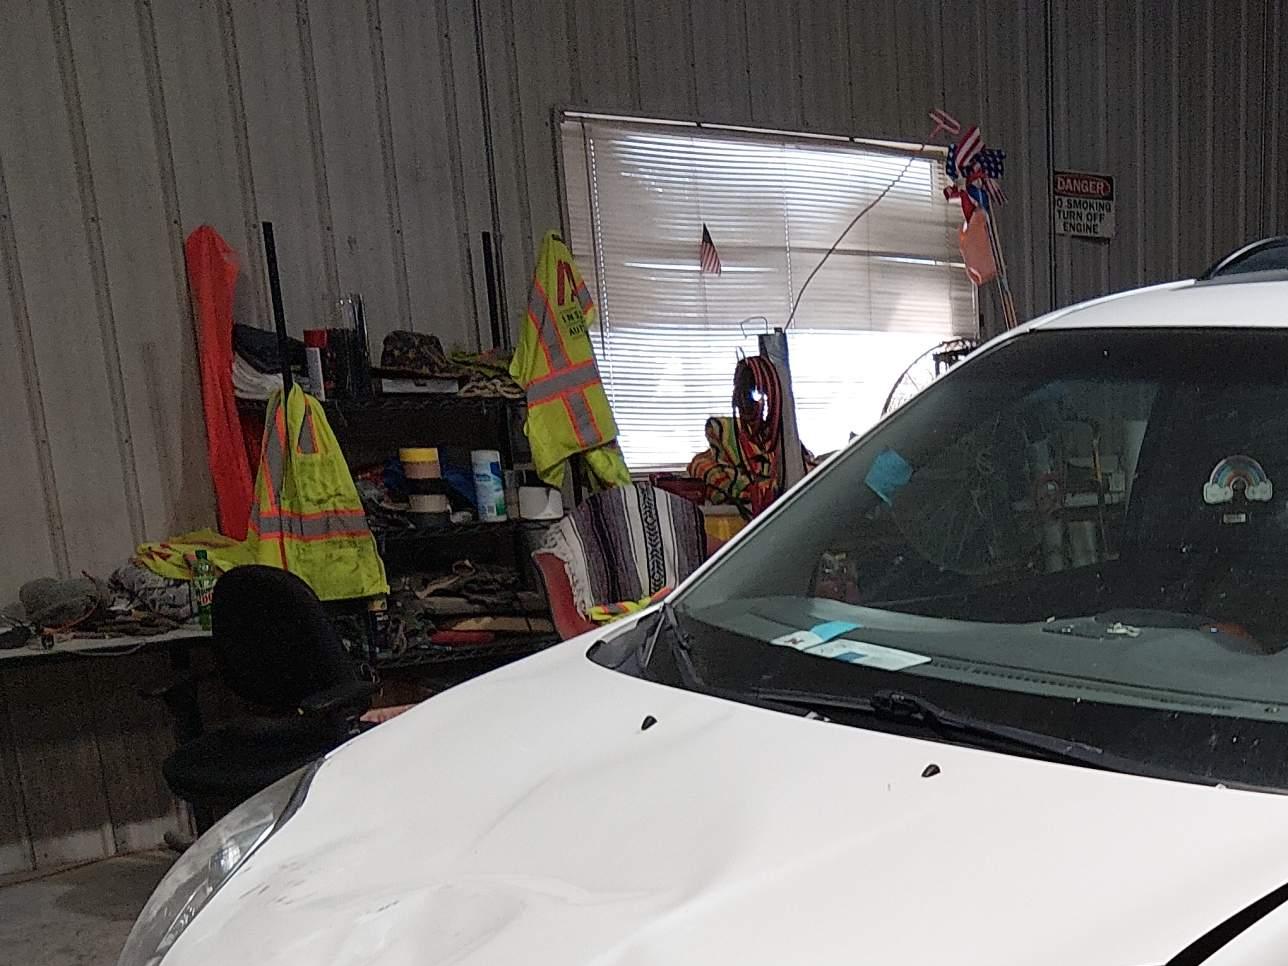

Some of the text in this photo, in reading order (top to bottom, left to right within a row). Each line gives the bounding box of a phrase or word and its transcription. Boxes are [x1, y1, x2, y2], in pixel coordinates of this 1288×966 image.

[1057, 176, 1105, 196] DANGER
[1067, 199, 1111, 212] SMOKING
[1058, 209, 1105, 222] TURN OFF
[1063, 221, 1099, 234] ENGINE
